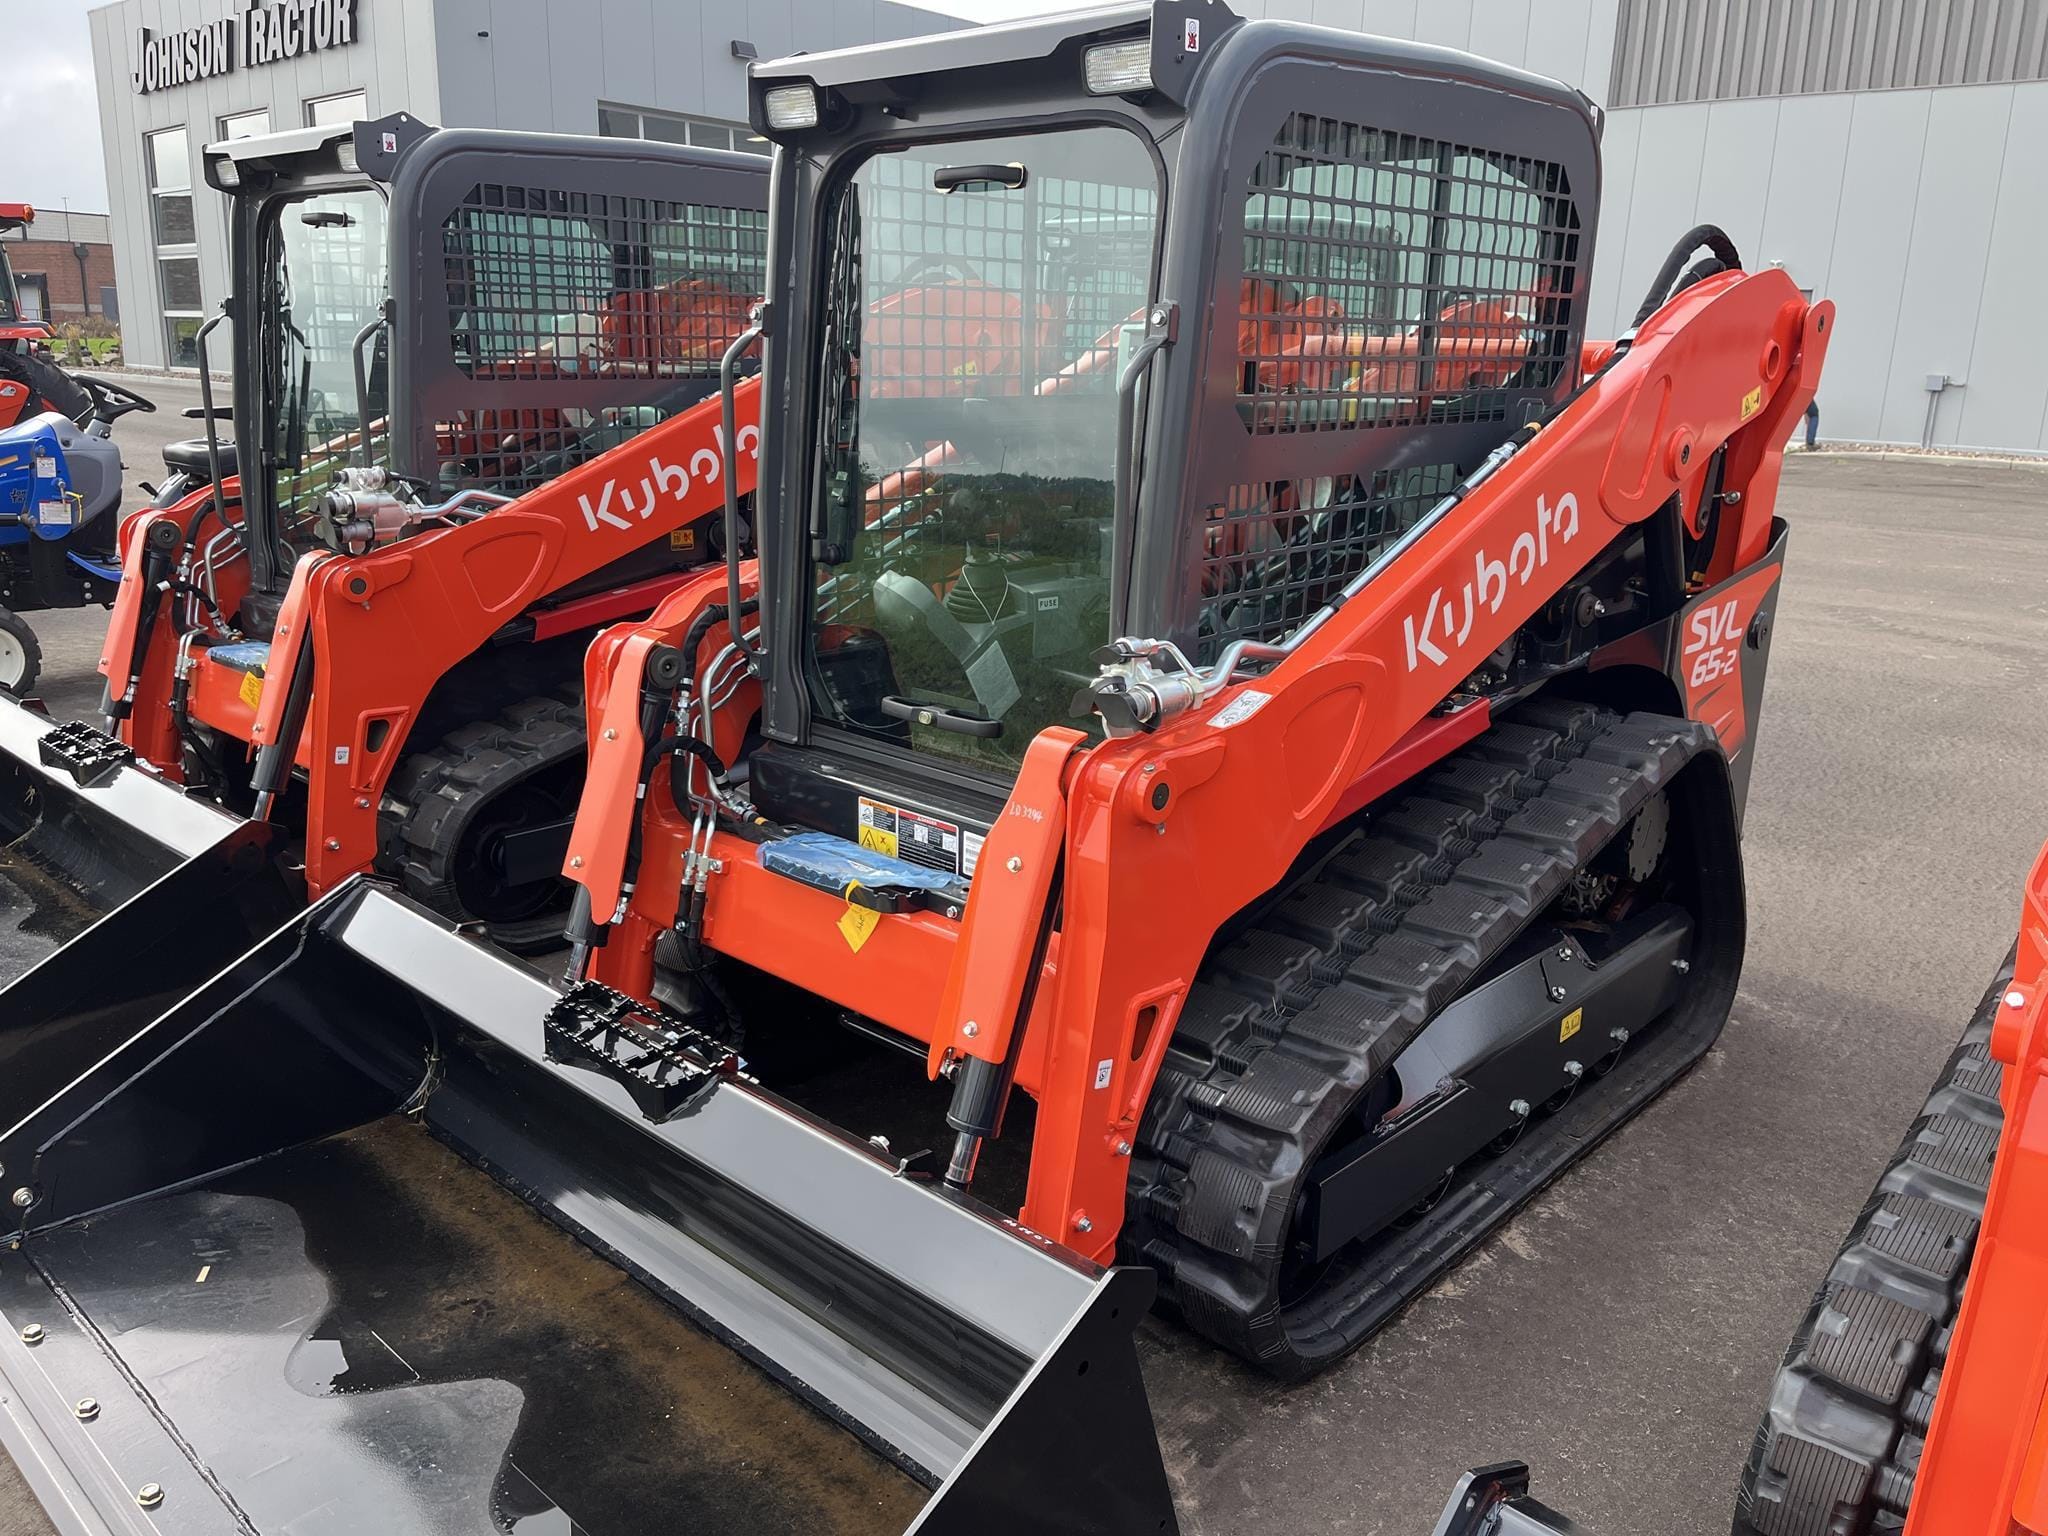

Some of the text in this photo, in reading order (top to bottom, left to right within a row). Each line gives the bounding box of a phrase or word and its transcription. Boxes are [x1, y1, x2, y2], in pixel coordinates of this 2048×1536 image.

[131, 0, 356, 95] JOHNSON TRACTOR
[1039, 599, 1057, 608] FUSE
[1403, 492, 1579, 673] Kubota
[1684, 600, 1742, 655] SVL
[1690, 647, 1737, 688] 65-2
